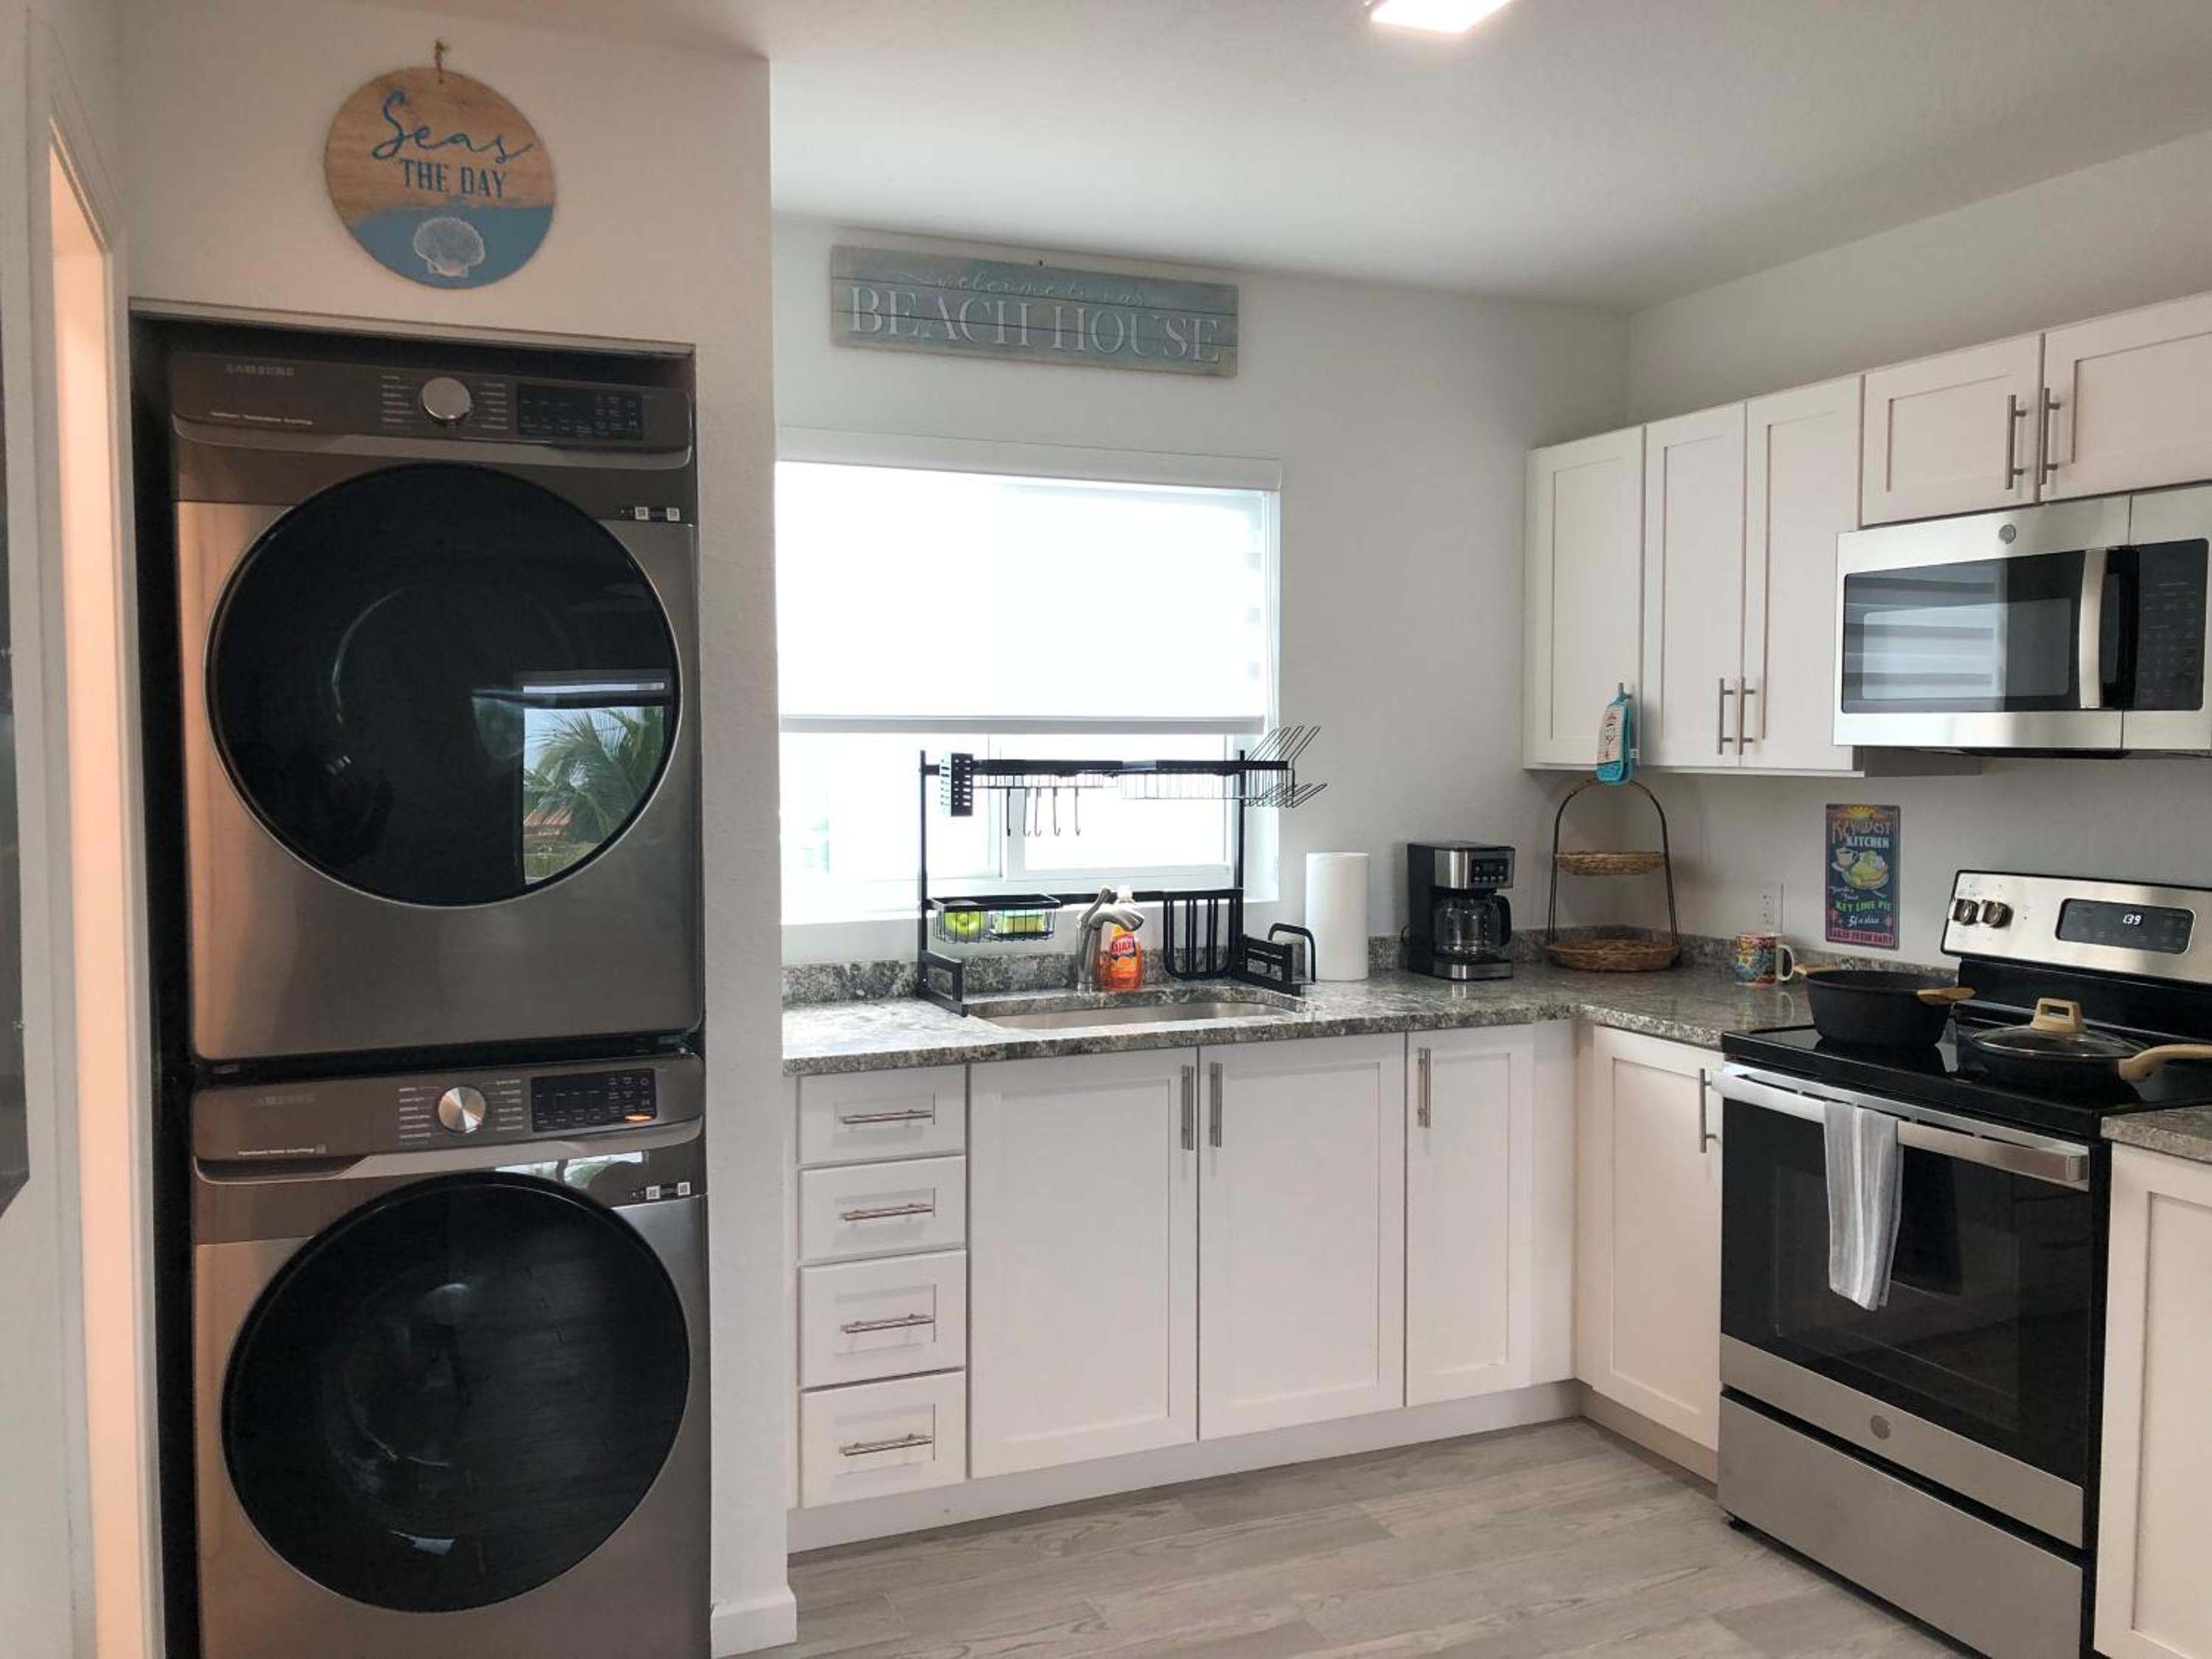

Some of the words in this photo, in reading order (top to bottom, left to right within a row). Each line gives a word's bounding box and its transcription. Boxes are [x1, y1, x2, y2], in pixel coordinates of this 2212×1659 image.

[372, 89, 535, 164] Seas
[400, 158, 449, 192] THE
[460, 166, 507, 198] DAY
[849, 285, 1032, 347] BEACH
[1050, 305, 1221, 363] HOUSE
